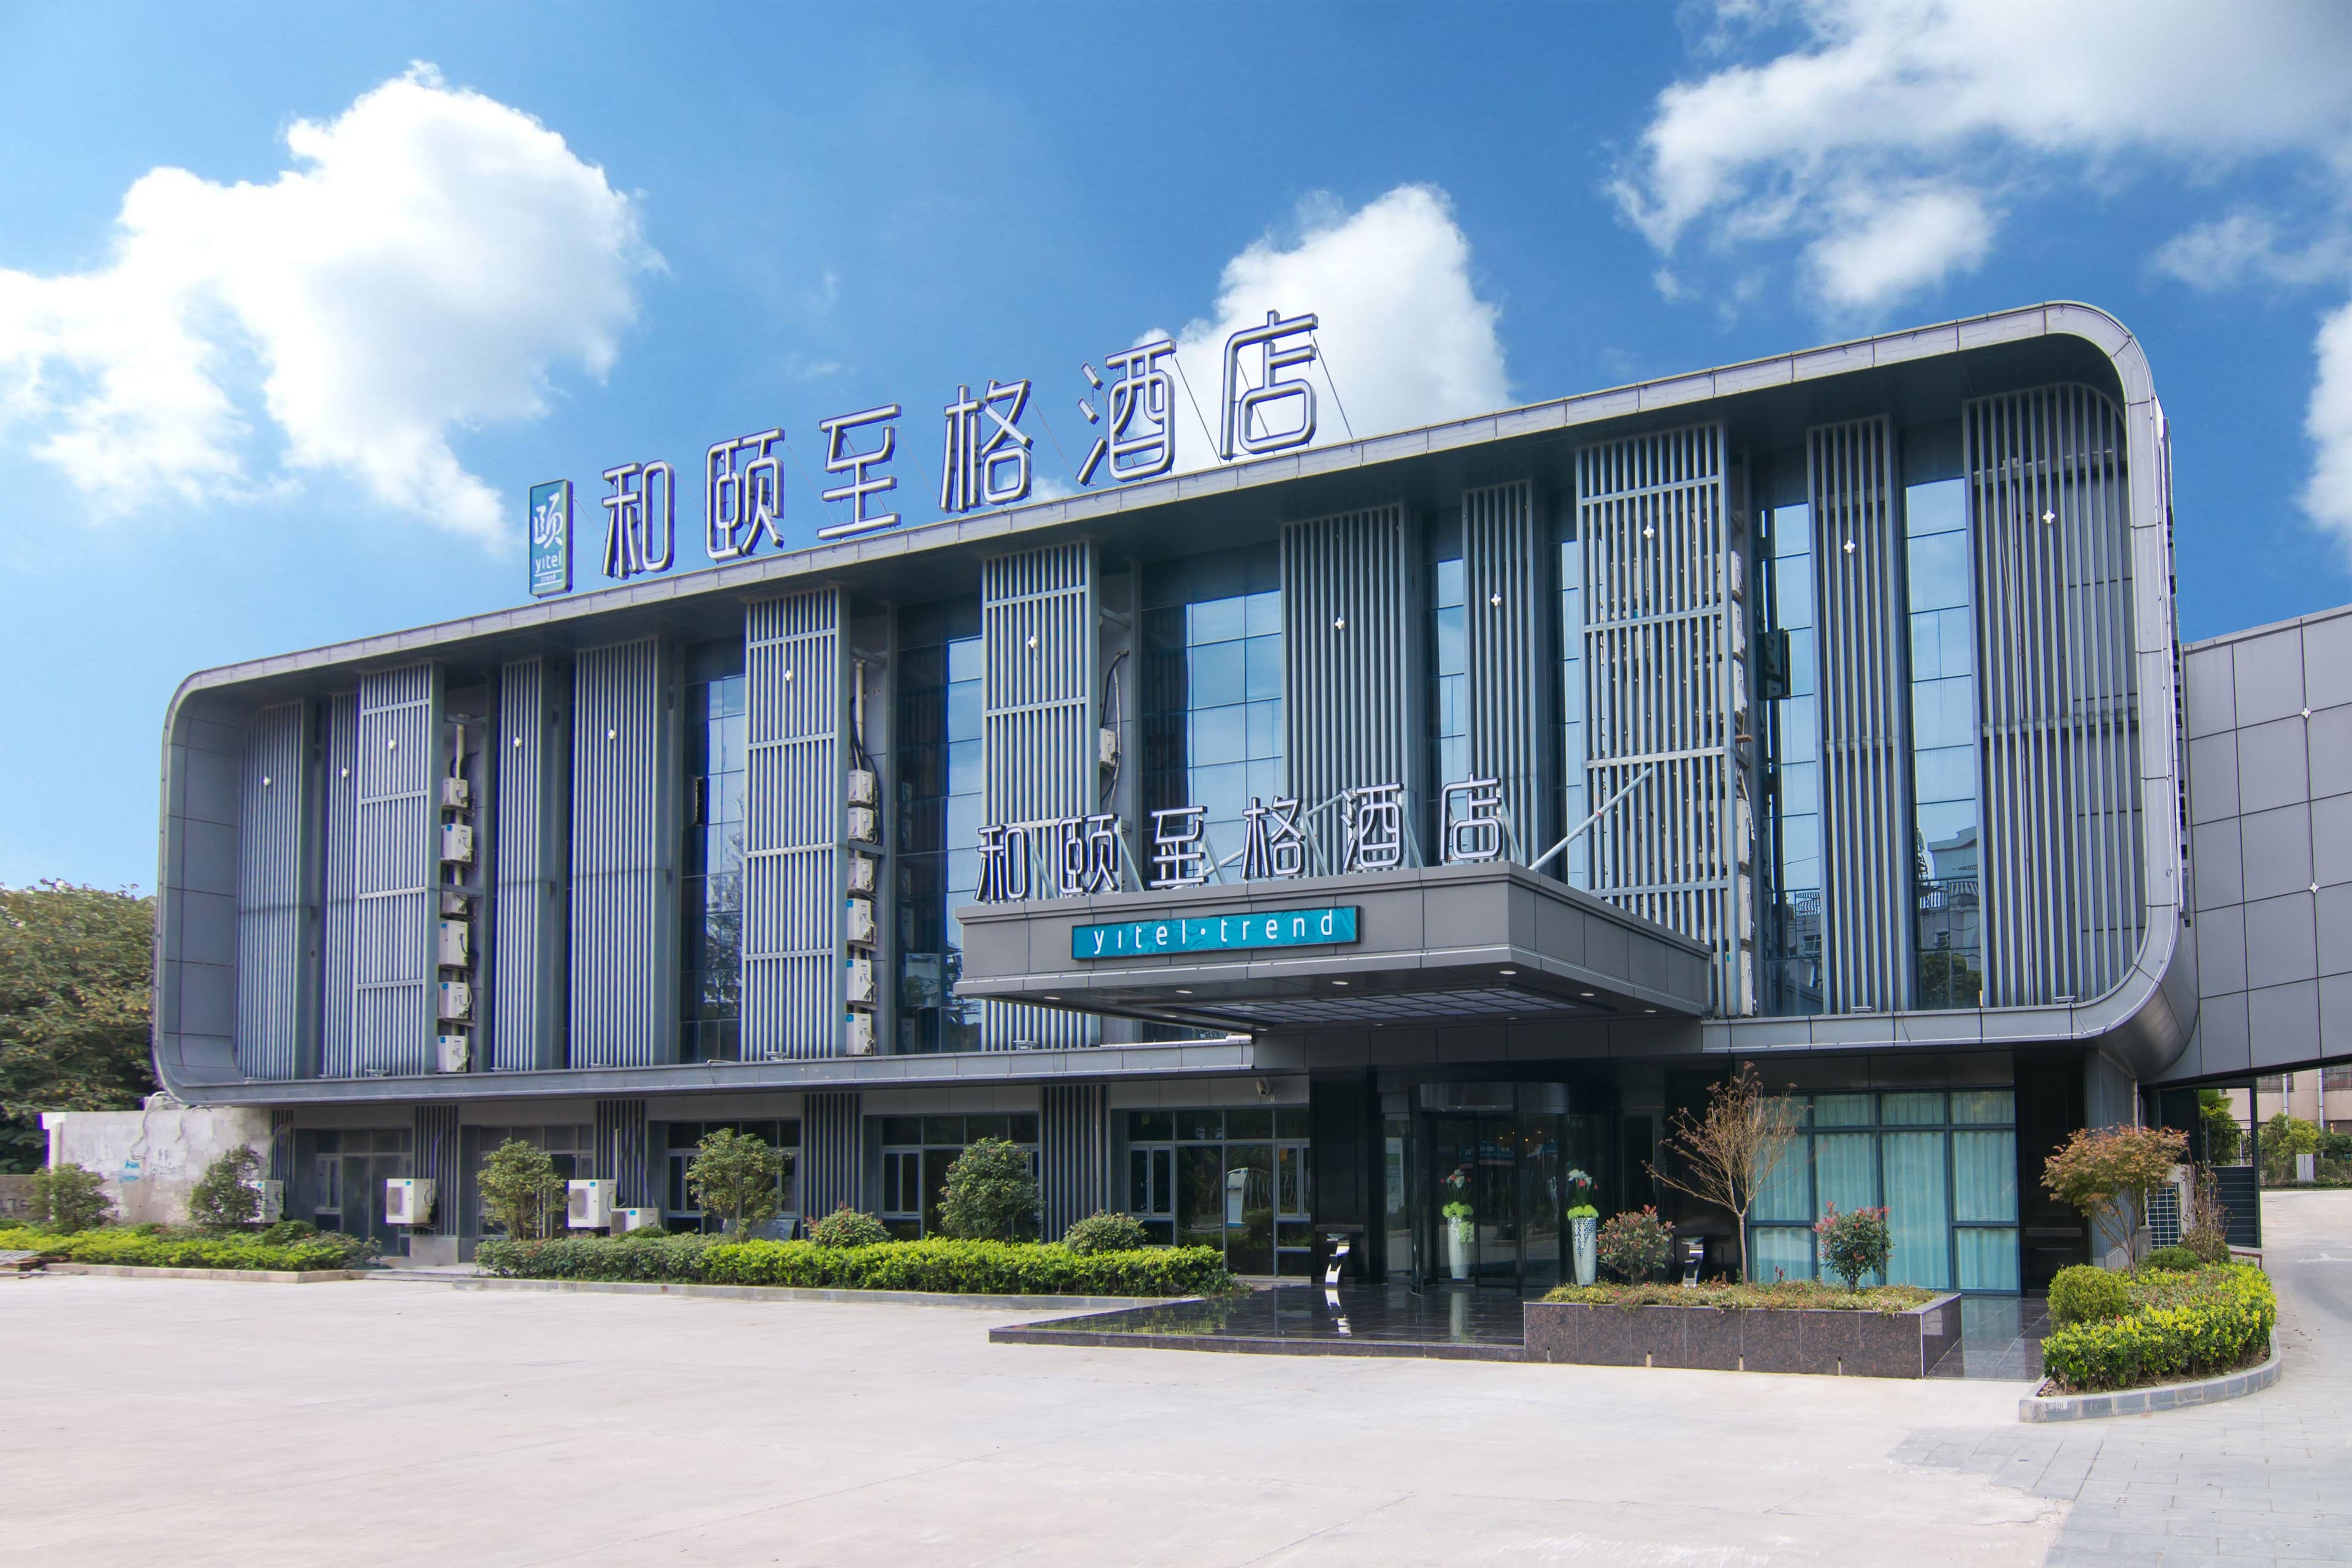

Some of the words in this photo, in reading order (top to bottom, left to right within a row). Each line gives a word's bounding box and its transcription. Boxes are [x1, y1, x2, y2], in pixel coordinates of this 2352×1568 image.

[601, 309, 1319, 580] 和颐至格酒店
[535, 550, 562, 574] yitel
[974, 772, 1502, 902] 和颐至格酒店
